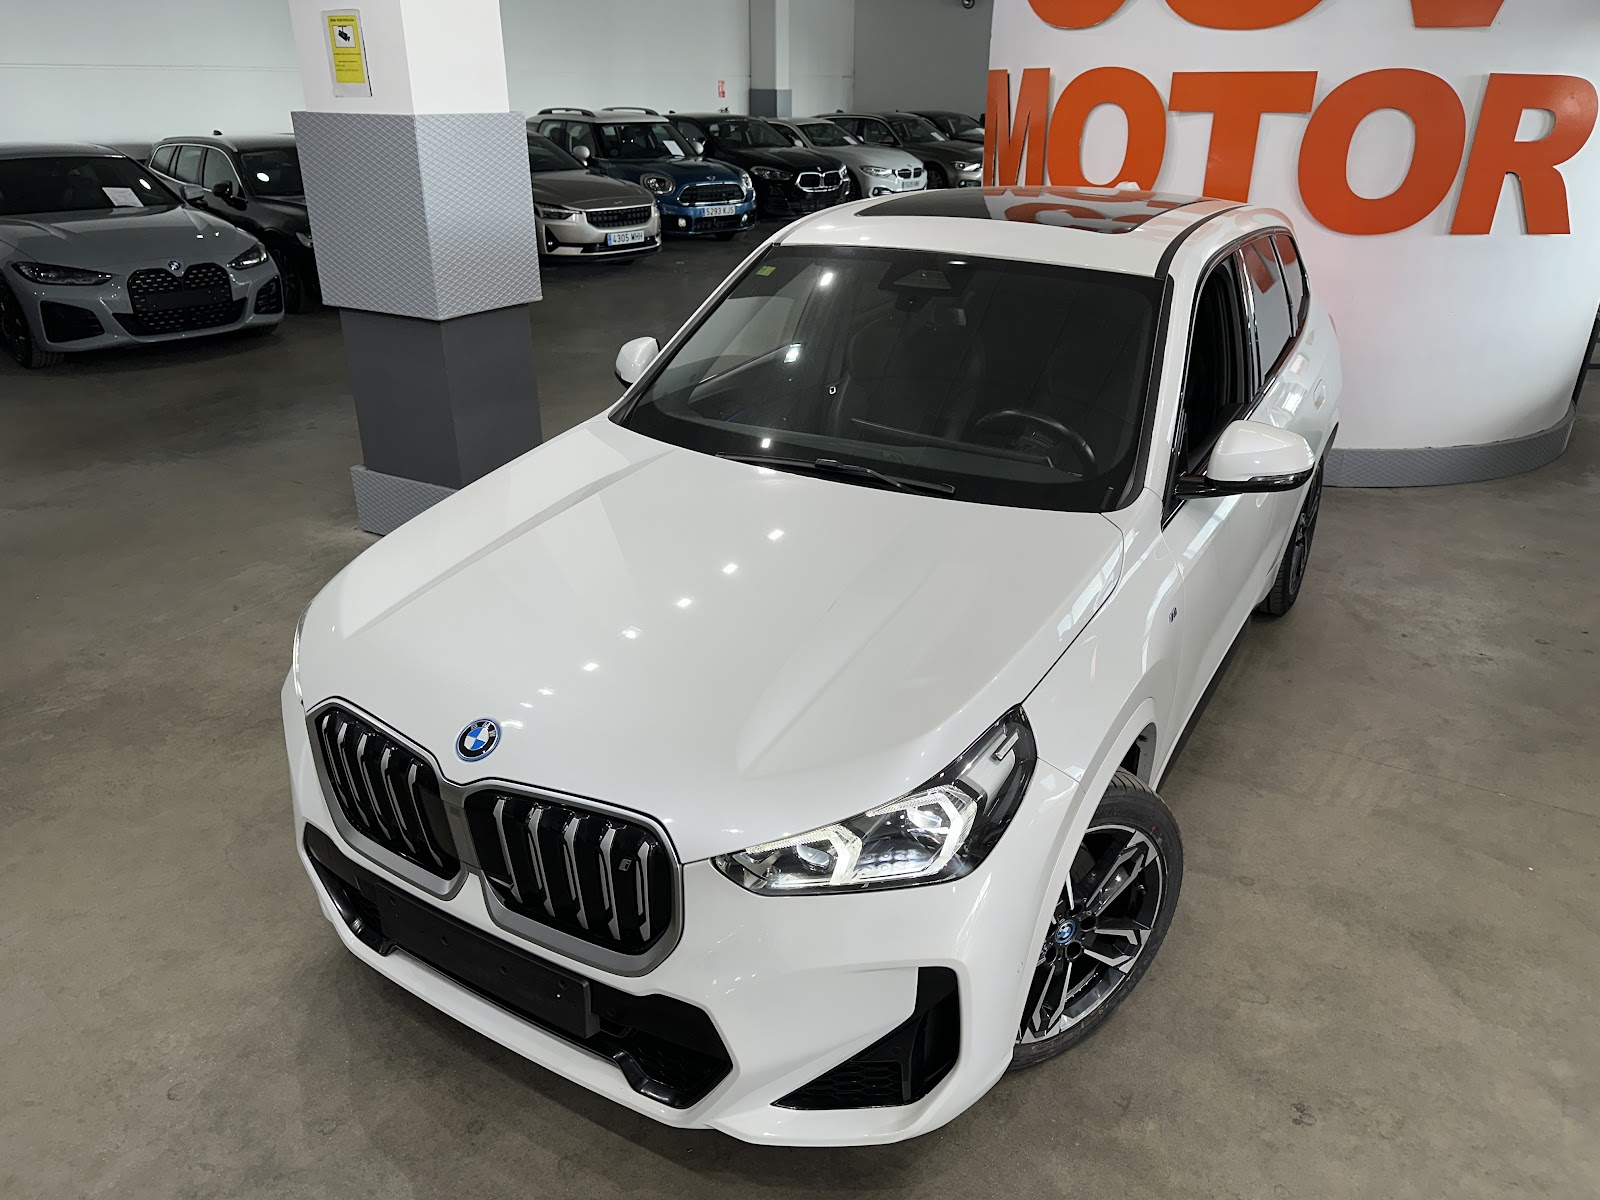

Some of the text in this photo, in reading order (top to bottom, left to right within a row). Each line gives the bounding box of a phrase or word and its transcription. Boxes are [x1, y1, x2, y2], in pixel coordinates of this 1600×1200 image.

[983, 66, 1599, 235] MOTOR
[706, 206, 735, 216] 5293 KJS
[612, 233, 630, 243] 4305
